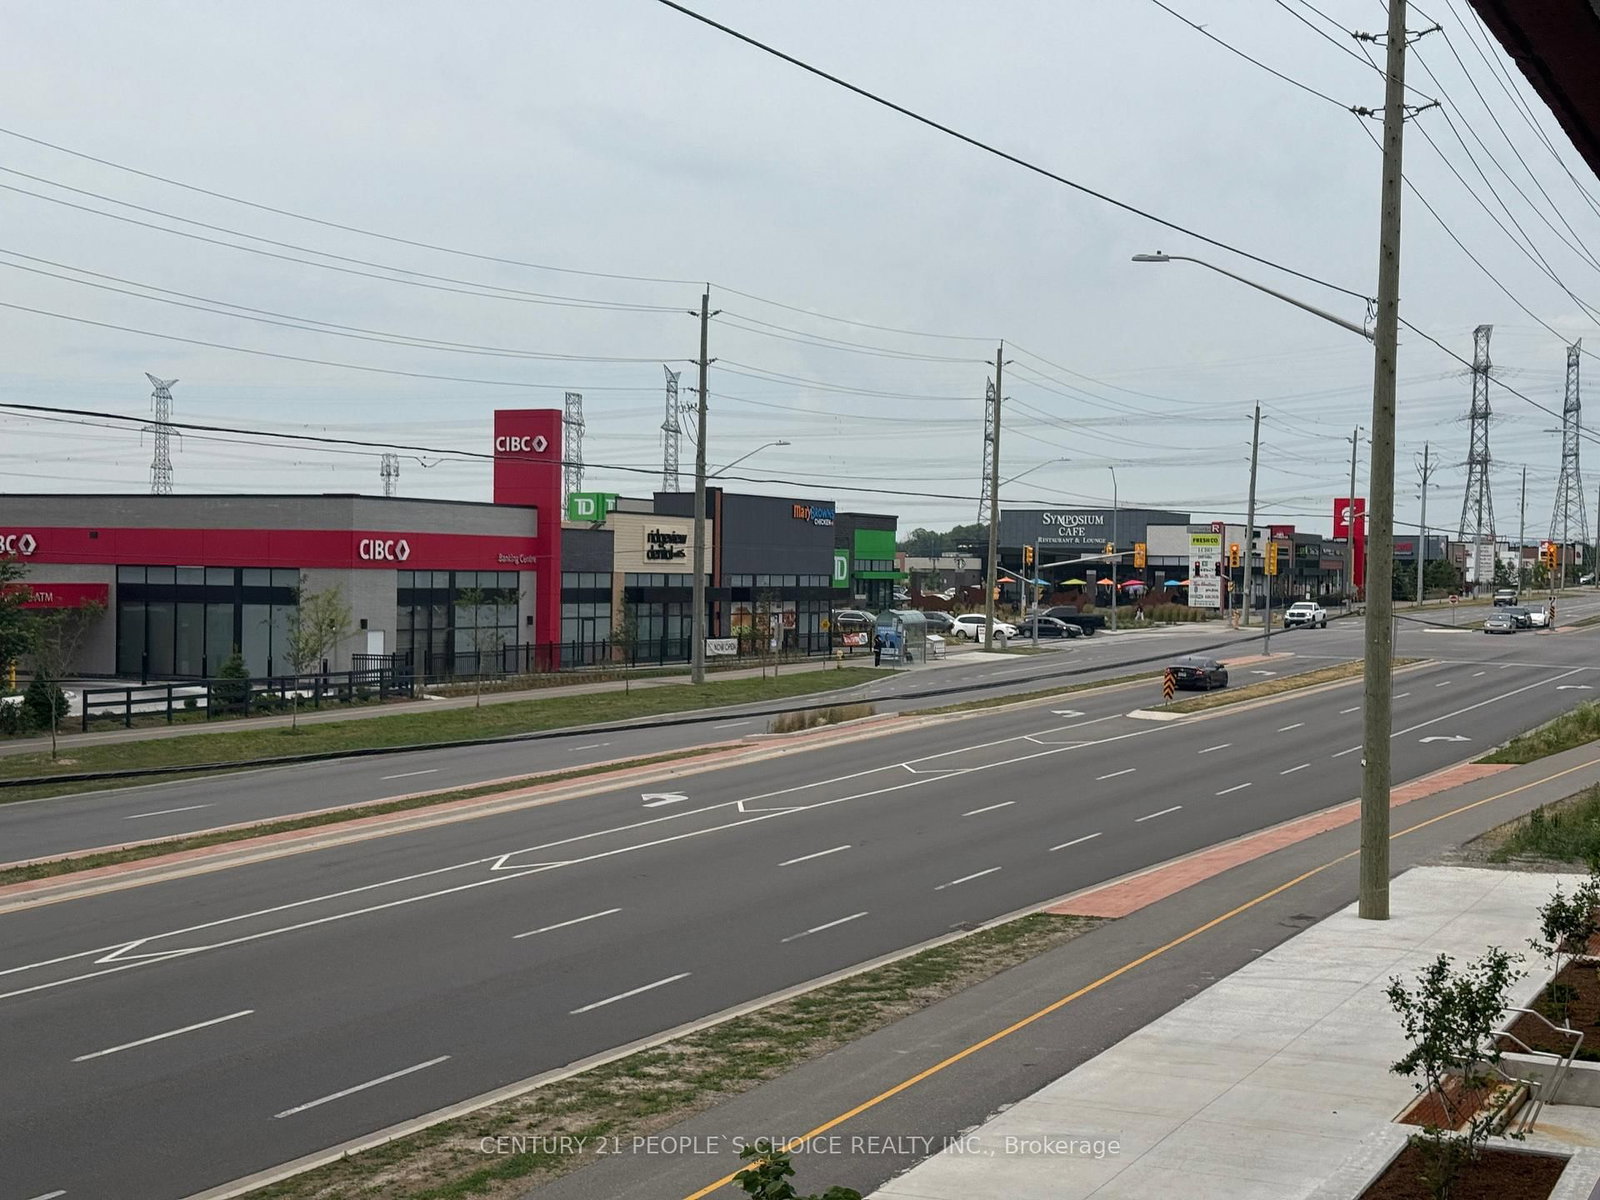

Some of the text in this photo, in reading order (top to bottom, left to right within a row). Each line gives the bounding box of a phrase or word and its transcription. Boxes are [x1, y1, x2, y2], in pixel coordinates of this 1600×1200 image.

[496, 436, 531, 452] CIBC
[574, 498, 595, 515] TD
[1042, 512, 1104, 527] SYMPOSIUM
[1058, 527, 1086, 536] CAFE
[1211, 524, 1220, 533] R
[359, 539, 395, 560] CIBC
[34, 592, 54, 602] ATM
